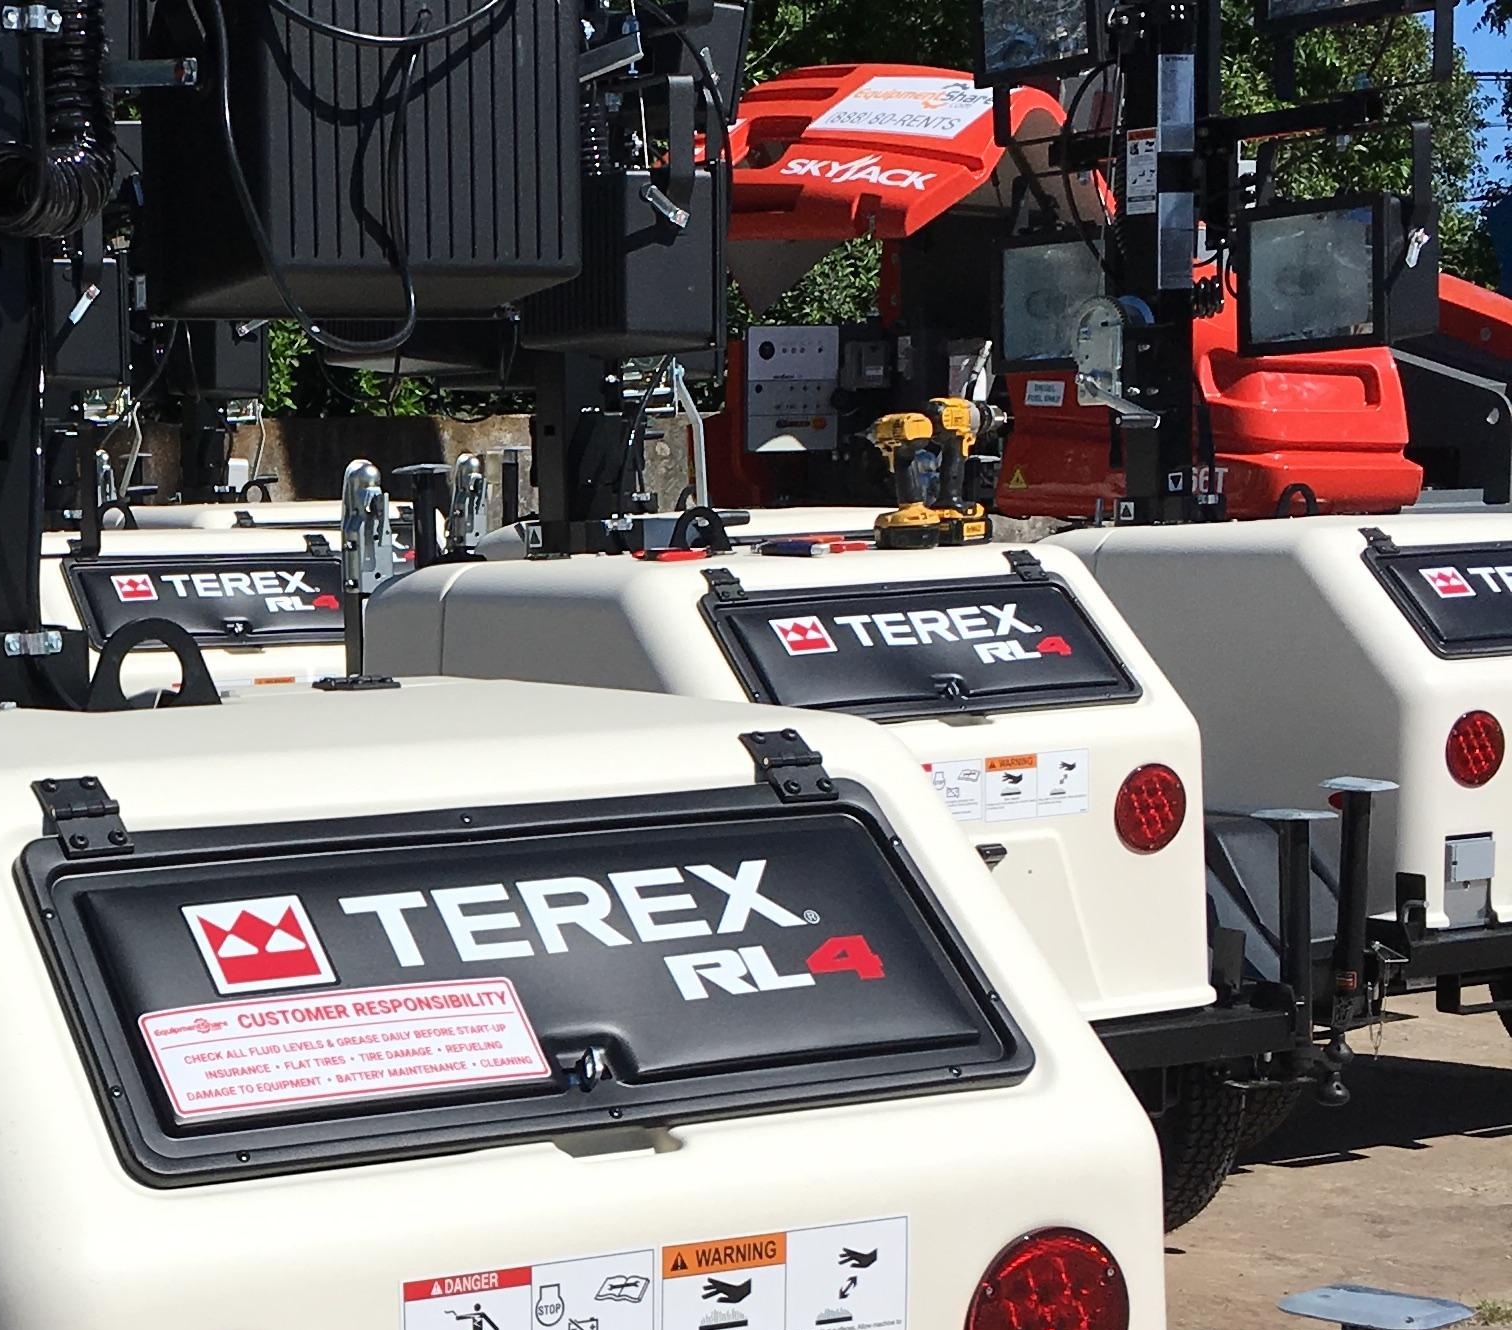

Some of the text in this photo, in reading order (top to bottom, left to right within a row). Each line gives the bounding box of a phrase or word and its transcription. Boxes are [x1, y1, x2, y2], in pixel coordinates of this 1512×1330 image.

[825, 110, 962, 131] (888) 80-RENTS
[780, 153, 937, 191] SKYJACK
[161, 571, 316, 598] TEREX
[264, 593, 340, 613] RL4
[834, 603, 1036, 647] TEREX
[973, 635, 1073, 664] RL4
[998, 756, 1035, 768] WARNING
[338, 859, 809, 968] TEREX
[663, 933, 887, 1002] RL4
[237, 1003, 350, 1030] CUSTOMER
[352, 990, 507, 1018] RESPONSIBILITY
[184, 1023, 507, 1065] CHECK ALL FLUID LEVELS & GREASE DAILY BEFORE START-UP
[204, 1040, 504, 1080] INSURANCE FLAT TIRES TIRE DAMAGE REFUELING
[186, 1055, 534, 1102] DAMAGE TO EQUIPMENT BATTERY MAINTENANCE CLEANING
[695, 1240, 777, 1268] WARNING
[444, 1271, 499, 1295] DANGER
[538, 1301, 563, 1317] STOP
